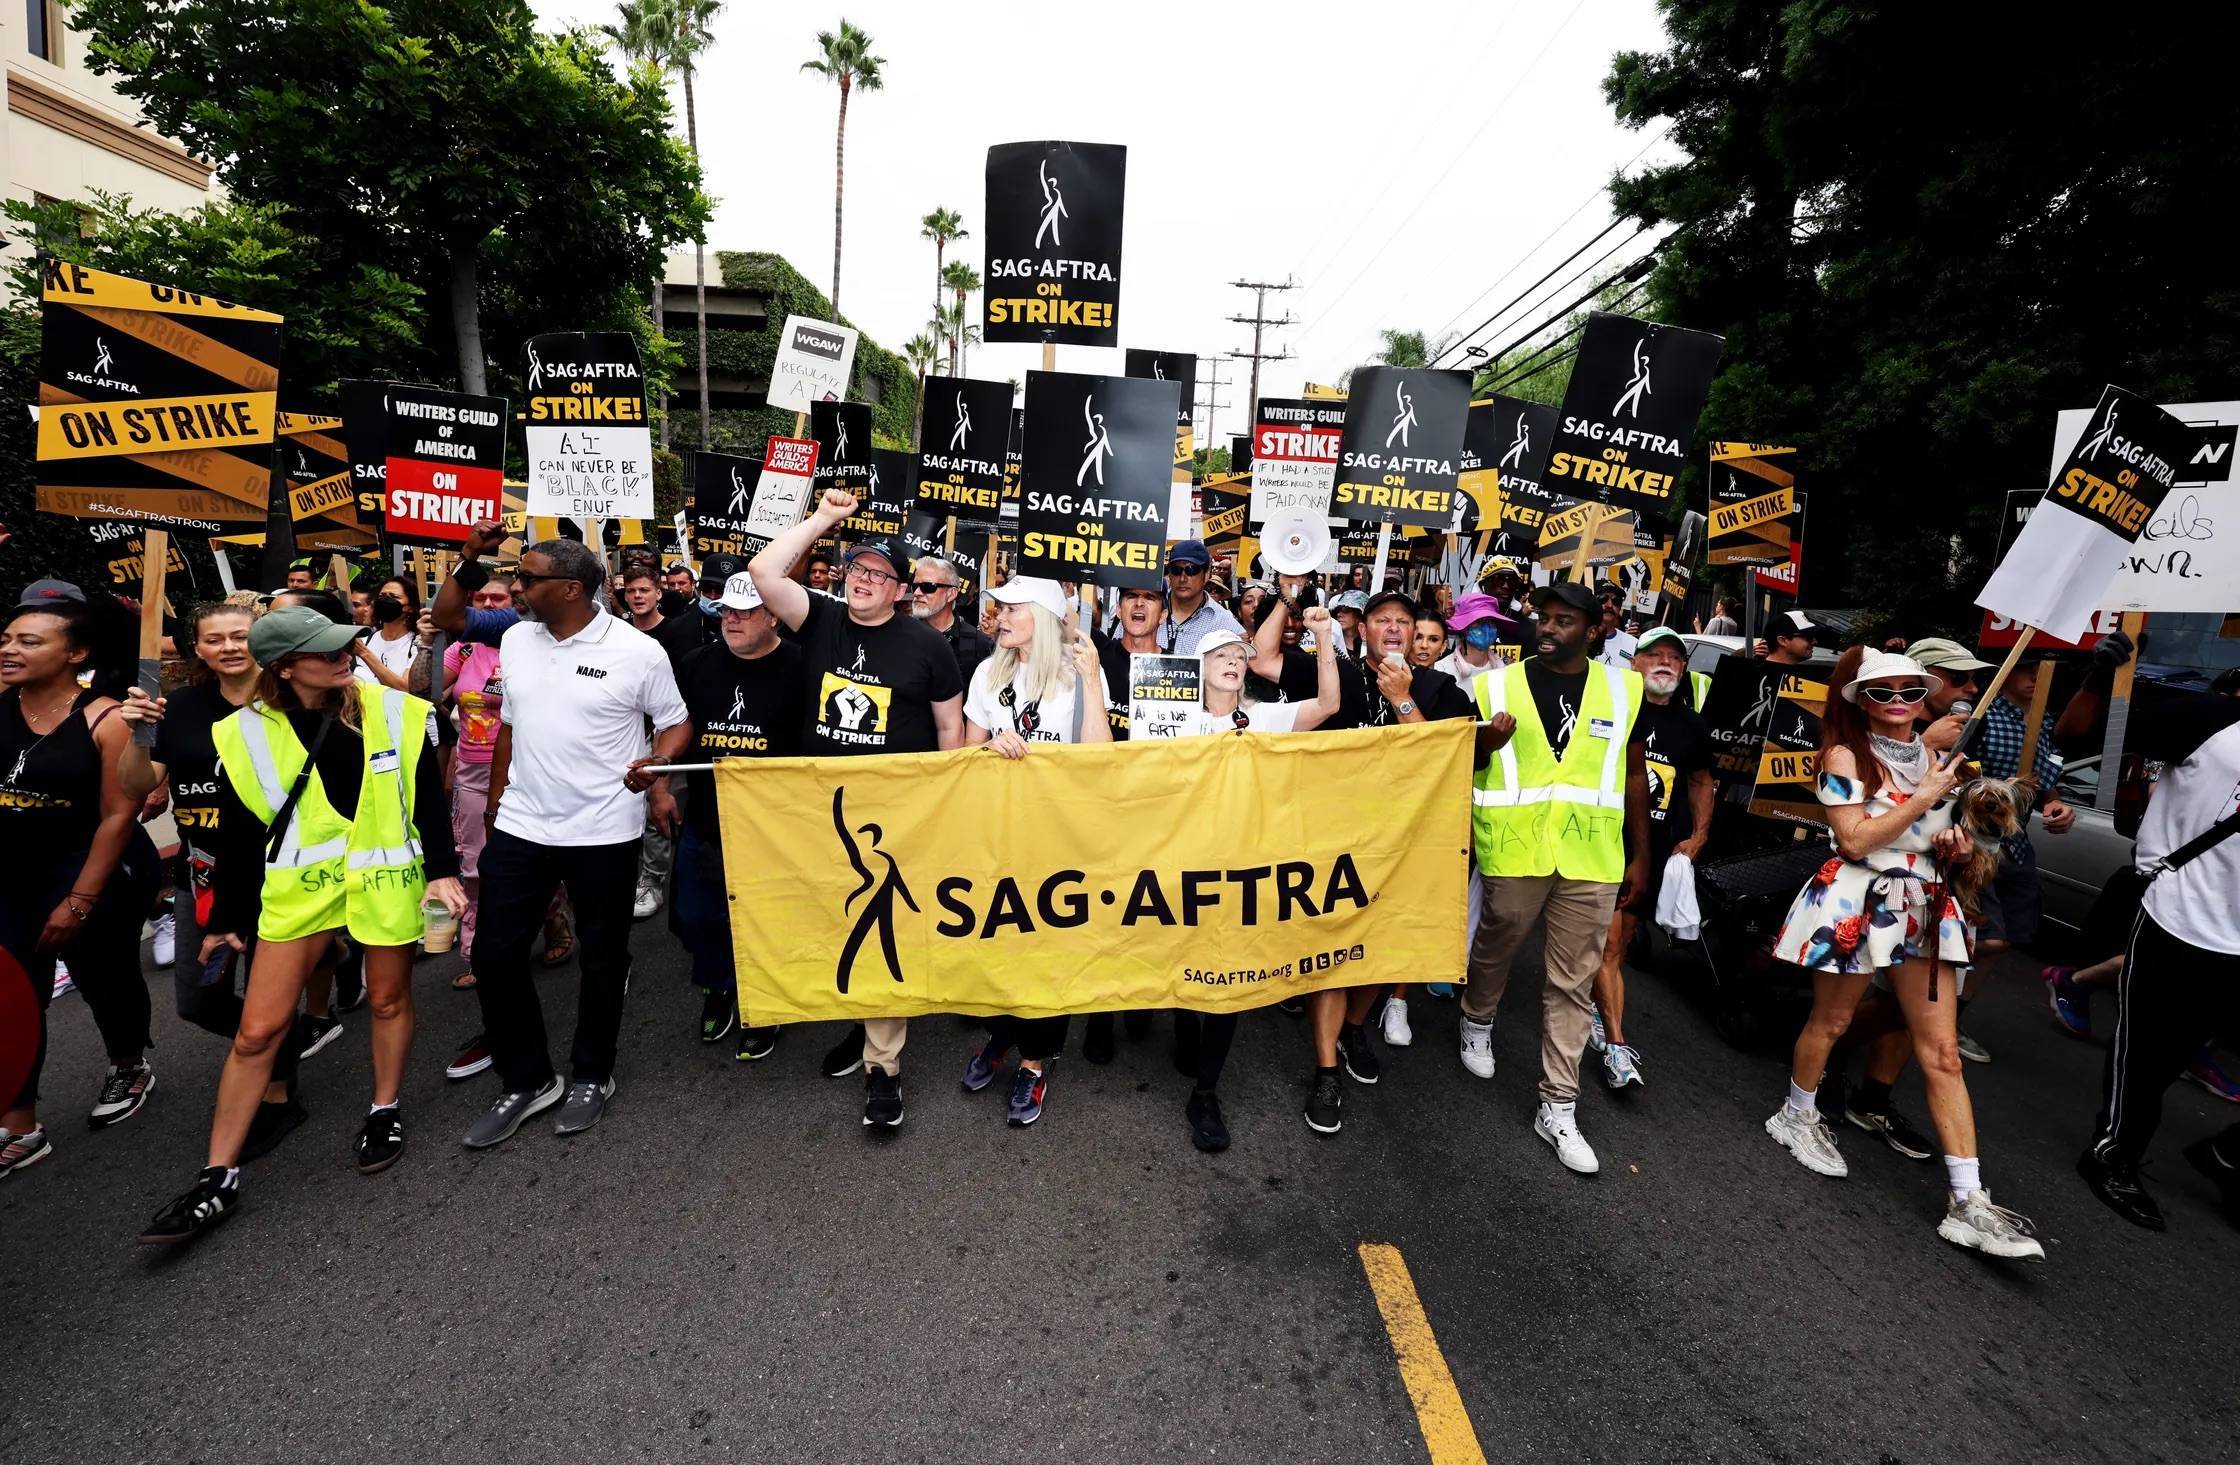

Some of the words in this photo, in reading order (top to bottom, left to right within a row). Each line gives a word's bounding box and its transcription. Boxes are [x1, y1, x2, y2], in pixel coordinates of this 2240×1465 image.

[1036, 283, 1062, 296] ON
[989, 298, 1113, 328] STRIKE!
[795, 332, 842, 354] WGAW
[781, 361, 842, 390] REGULATE
[571, 382, 593, 395] ON
[396, 400, 456, 422] WRITERS
[458, 408, 498, 427] GUILD
[530, 396, 642, 421] STRIKE!
[1264, 406, 1316, 421] WRITERS
[59, 412, 118, 449] ON
[123, 401, 259, 444] STRIKE
[438, 426, 453, 438] OF
[1301, 423, 1312, 432] ON
[415, 439, 476, 461] AMERICA
[774, 441, 814, 454] WRITERS
[1261, 431, 1340, 459] STRIKE
[773, 450, 800, 463] GUILD
[1602, 447, 1628, 464] ON
[538, 460, 565, 473] CAN
[571, 460, 615, 474] NEVER
[622, 460, 638, 474] BE
[768, 459, 809, 473] AMERICA
[1258, 463, 1268, 472] IF
[1271, 463, 1275, 472] I
[1281, 464, 1301, 475] HAD
[1550, 452, 1674, 498] STRIKE!
[432, 471, 457, 490] ON
[835, 479, 846, 487] ON
[948, 474, 964, 485] ON
[1318, 480, 1330, 489] BE
[1383, 474, 1406, 486] ON
[2117, 469, 2139, 489] ON
[295, 489, 316, 513] ON
[919, 481, 998, 508] STRIKE!
[1266, 491, 1297, 509] PAID
[1336, 482, 1450, 512] STRIKE!
[2057, 468, 2152, 533] STRIKE!
[391, 488, 495, 526] STRIKE!
[573, 499, 612, 514] ENUF
[861, 511, 875, 519] ON
[869, 501, 901, 513] FTRA
[1717, 510, 1739, 530] ON
[1740, 493, 1787, 523] STRIKE
[88, 502, 221, 532] #SAGAFTRASTRONG
[1077, 521, 1104, 536] ON
[1208, 520, 1222, 533] ON
[1546, 516, 1570, 537] ON
[904, 532, 978, 571] SAG·ATRA
[1023, 532, 1159, 570] STRIKE!
[576, 665, 607, 679] NAACP
[1133, 686, 1198, 700] STRIKE!
[1157, 709, 1166, 720] is
[816, 723, 830, 738] ON
[832, 730, 886, 745] STRIKE!
[1148, 722, 1182, 738] ART
[701, 733, 768, 750] STRONG
[1771, 757, 1796, 778] ON
[301, 861, 345, 892] SAG
[361, 863, 419, 892] AFTRA
[1184, 963, 1292, 985] SAGAFTRA.org
